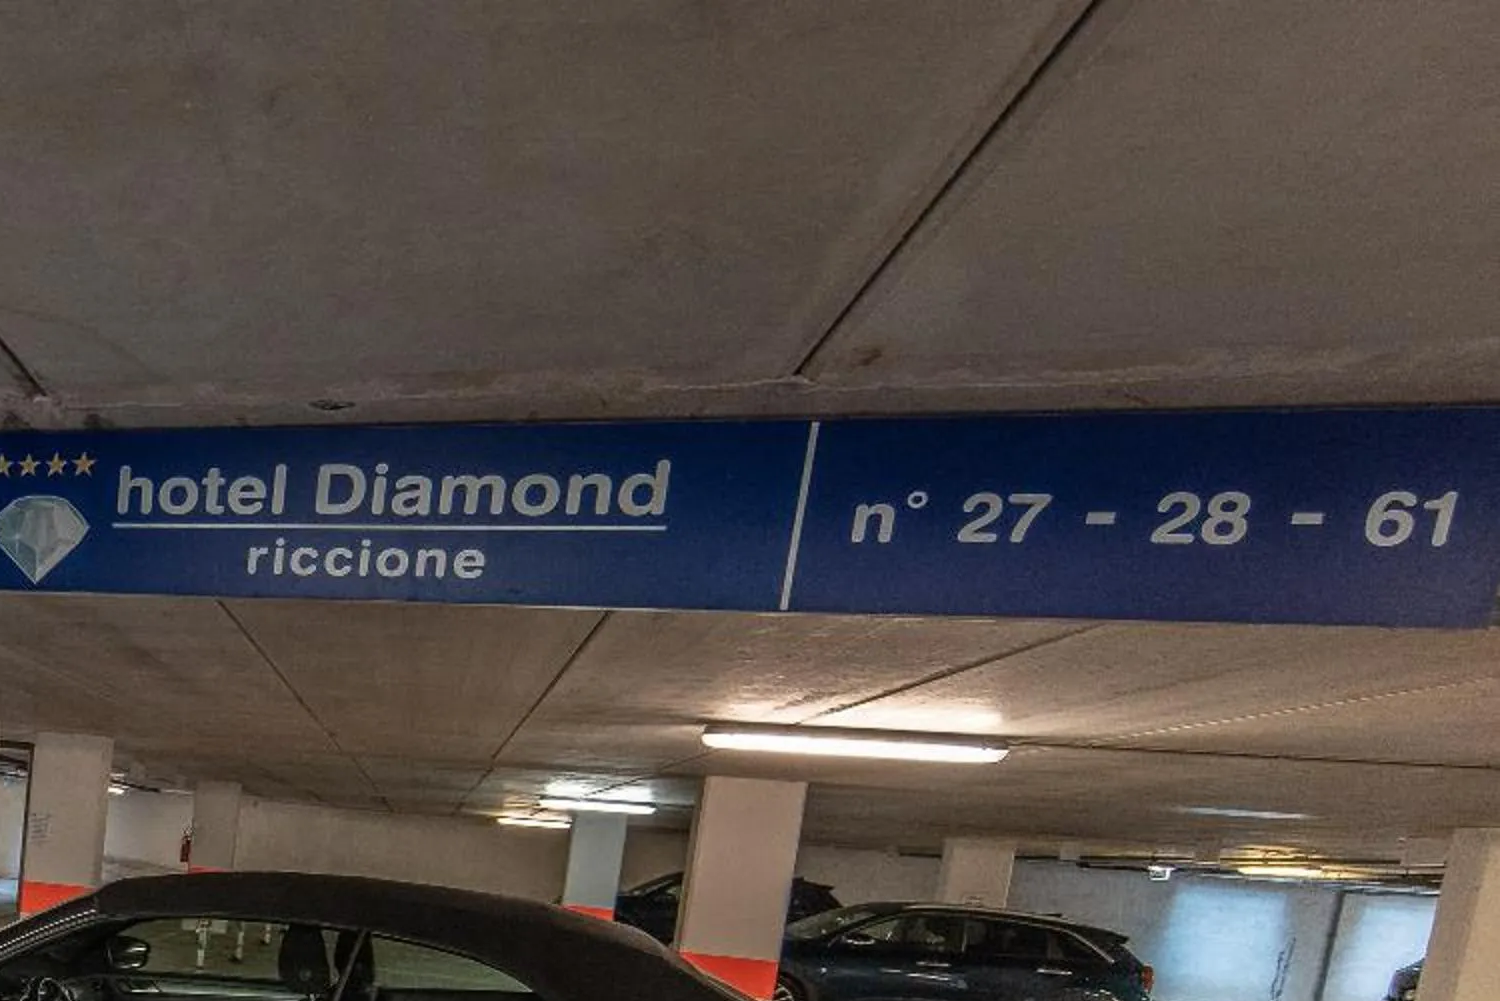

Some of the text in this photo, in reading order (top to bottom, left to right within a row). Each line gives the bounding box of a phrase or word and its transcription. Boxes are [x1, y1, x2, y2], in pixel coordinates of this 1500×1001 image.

[117, 458, 672, 517] hotel Diamond
[957, 491, 1053, 543] 27
[1150, 491, 1252, 545] 28
[1364, 490, 1460, 548] 61
[245, 537, 488, 580] riccione
